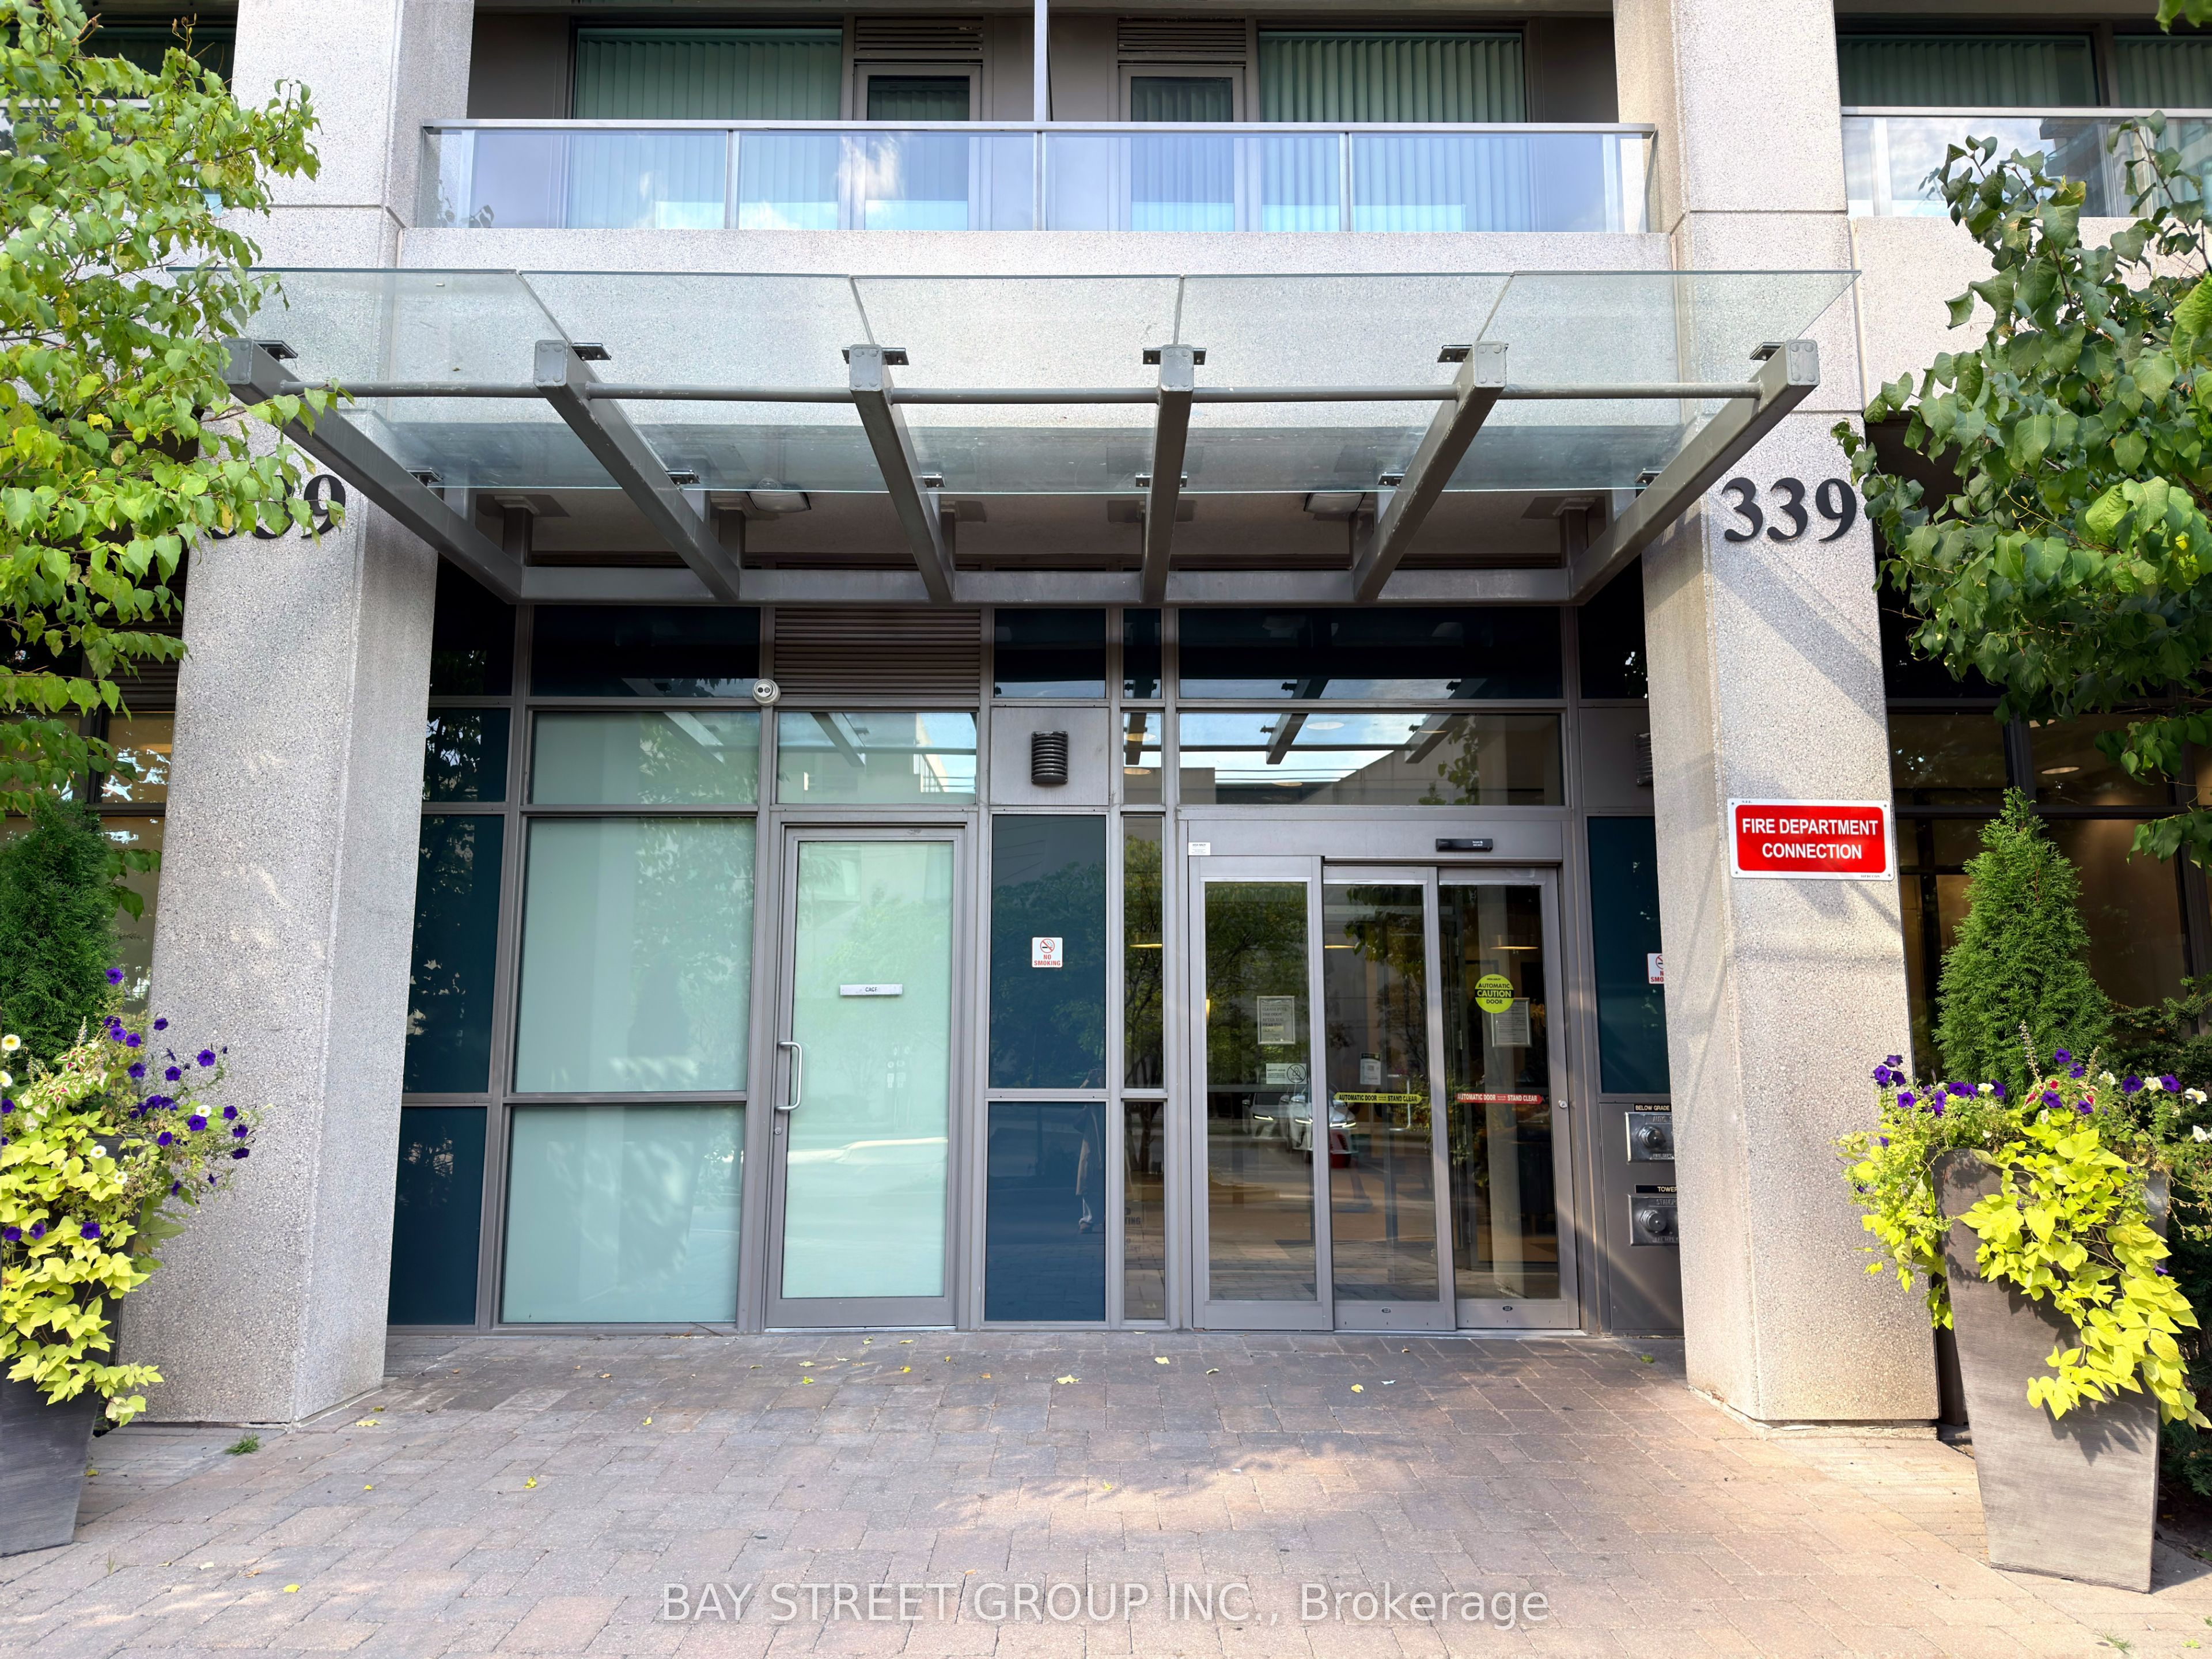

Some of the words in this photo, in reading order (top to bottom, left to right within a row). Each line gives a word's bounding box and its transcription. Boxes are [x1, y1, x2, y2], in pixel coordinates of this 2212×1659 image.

[1721, 477, 1857, 541] 339
[1742, 818, 1775, 834] FIRE
[1779, 819, 1878, 835] DEPARTMENT
[1762, 843, 1862, 859] CONNECTION
